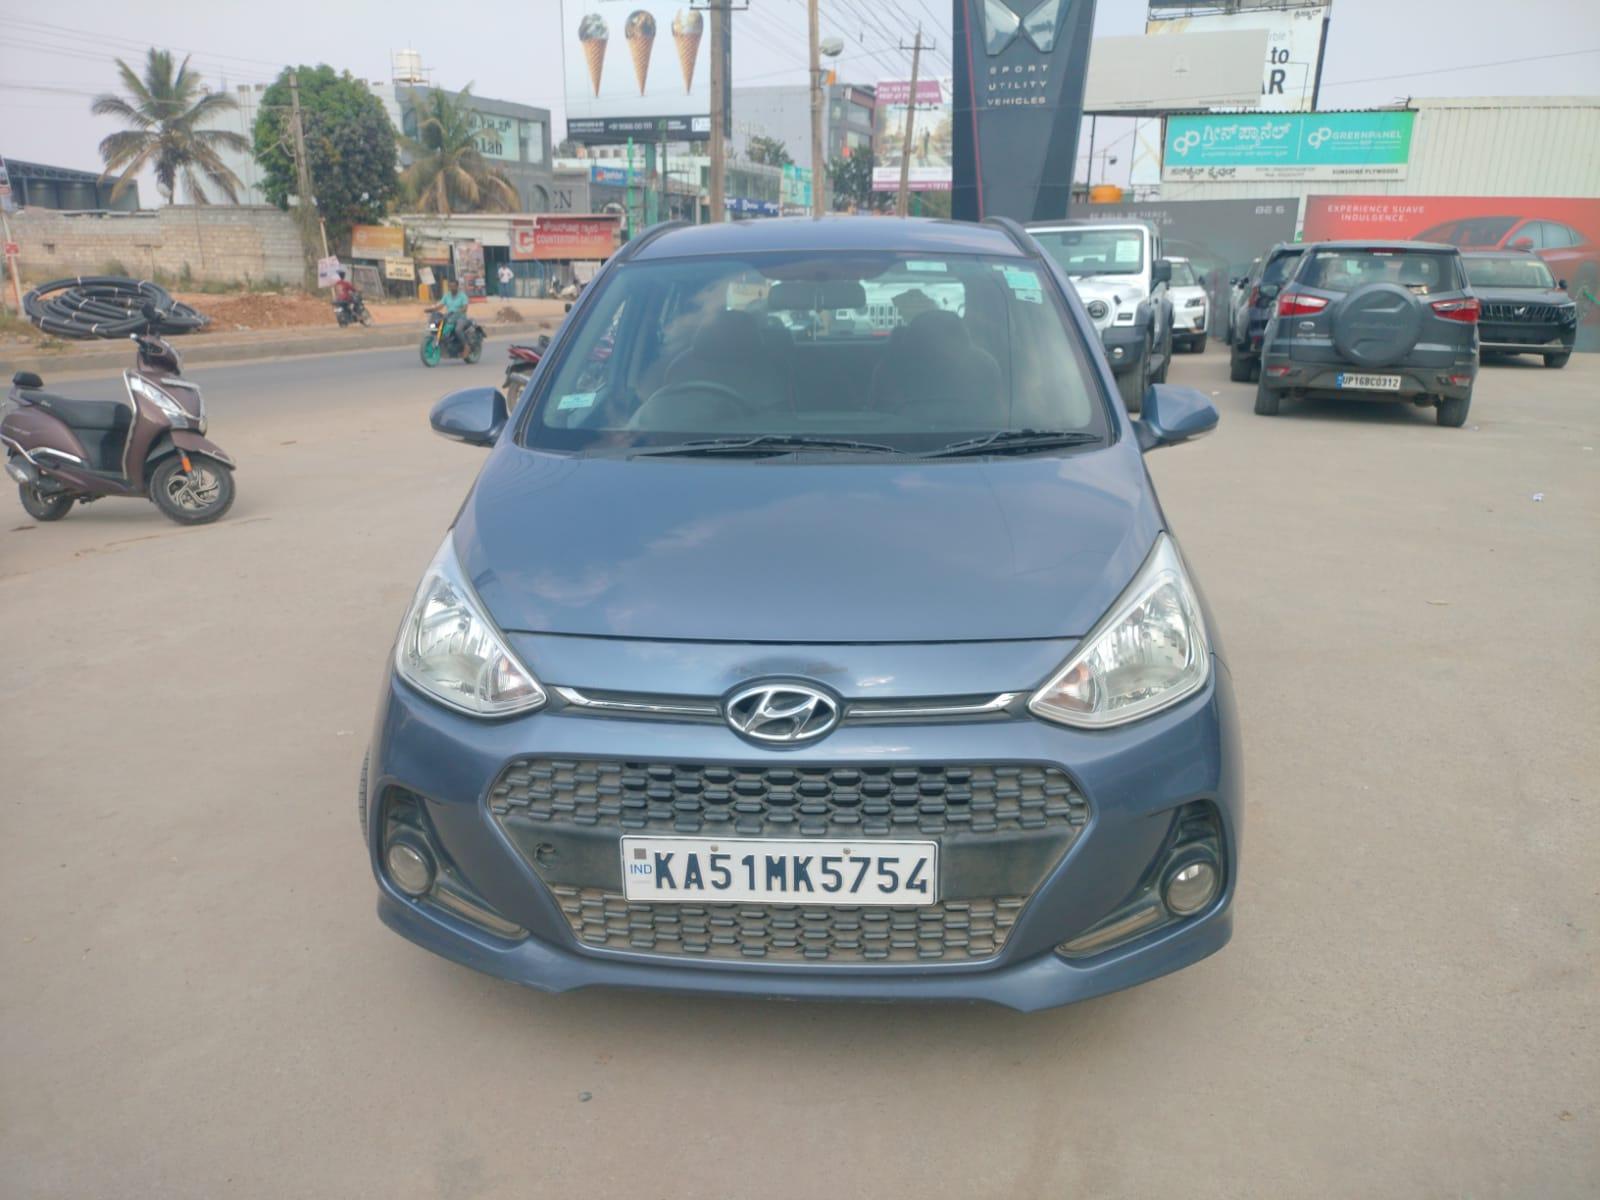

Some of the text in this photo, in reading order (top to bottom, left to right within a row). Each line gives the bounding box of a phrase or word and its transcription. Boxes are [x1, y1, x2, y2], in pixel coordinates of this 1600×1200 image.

[1271, 47, 1289, 64] to
[989, 64, 1048, 75] SPORT
[988, 80, 1047, 91] UTILITY
[987, 96, 1046, 106] VEHICLES
[1331, 130, 1402, 140] GREENPANEL
[1327, 204, 1424, 214] EXPERIENCE SUAVE
[1342, 374, 1399, 389] UP16BC0312
[630, 864, 652, 875] IND
[654, 852, 928, 894] KA51MK5754
